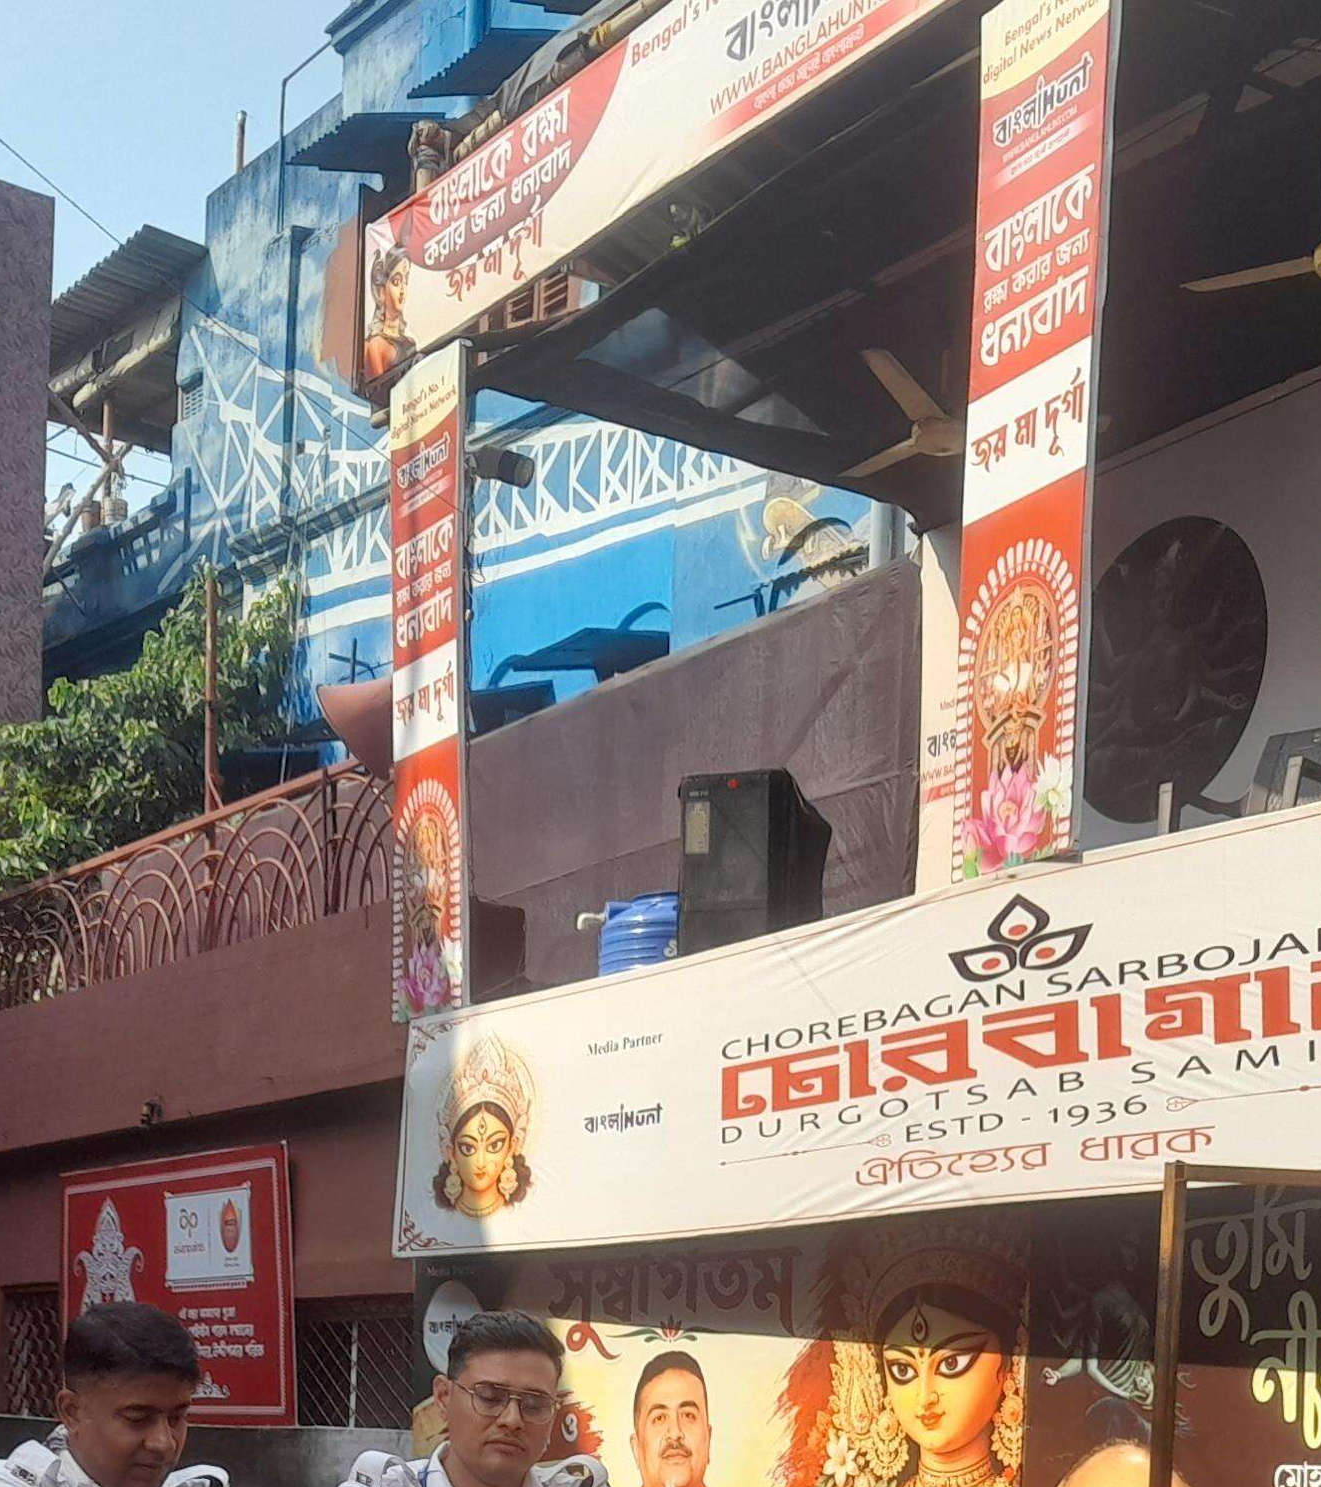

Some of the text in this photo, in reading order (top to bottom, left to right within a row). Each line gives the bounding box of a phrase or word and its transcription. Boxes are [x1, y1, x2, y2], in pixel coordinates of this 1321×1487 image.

[983, 54, 1017, 85] digital
[1020, 30, 1052, 58] News
[428, 88, 571, 225] বাংলাকে রক্ষা
[424, 140, 573, 266] করার জন্য ধন্যবাদ
[983, 163, 1095, 273] বাংলাকে
[482, 236, 505, 276] মা
[983, 227, 1090, 314] রক্ষা করার জন্য
[979, 265, 1090, 367] ধন্যবাদ
[1014, 406, 1038, 449] মা
[395, 513, 455, 580] বাংলাকে
[395, 586, 454, 648] ধন্যবাদ
[586, 1033, 664, 1057] Media Partner
[721, 979, 1027, 1062] CHOREBAGAN
[721, 1070, 1085, 1145] DURGOTSAB
[906, 1112, 1004, 1144] ESTD
[1050, 1095, 1149, 1127] 1936
[855, 1125, 1216, 1187] ঐতিহ্যের ধারক
